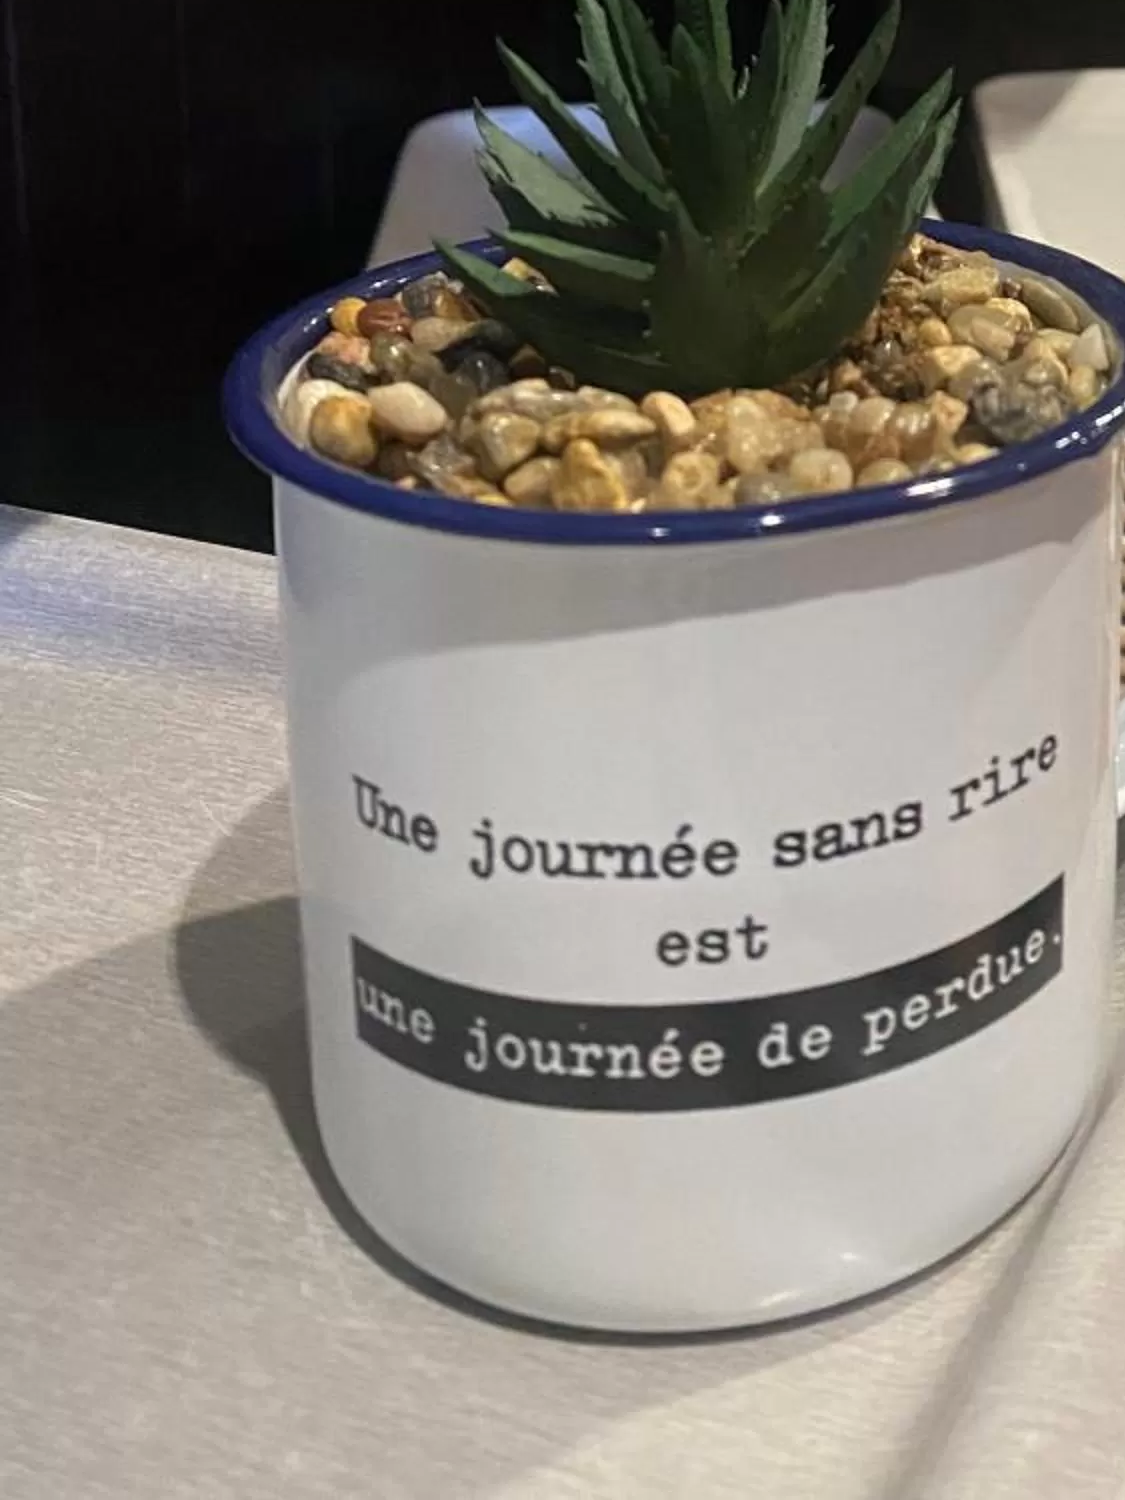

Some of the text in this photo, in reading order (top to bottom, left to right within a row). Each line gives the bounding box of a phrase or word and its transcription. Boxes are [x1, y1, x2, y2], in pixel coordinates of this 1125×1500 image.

[352, 732, 1059, 879] Une journée sans rire
[357, 924, 1063, 1079] une journée de perdue.
[655, 914, 770, 966] est
